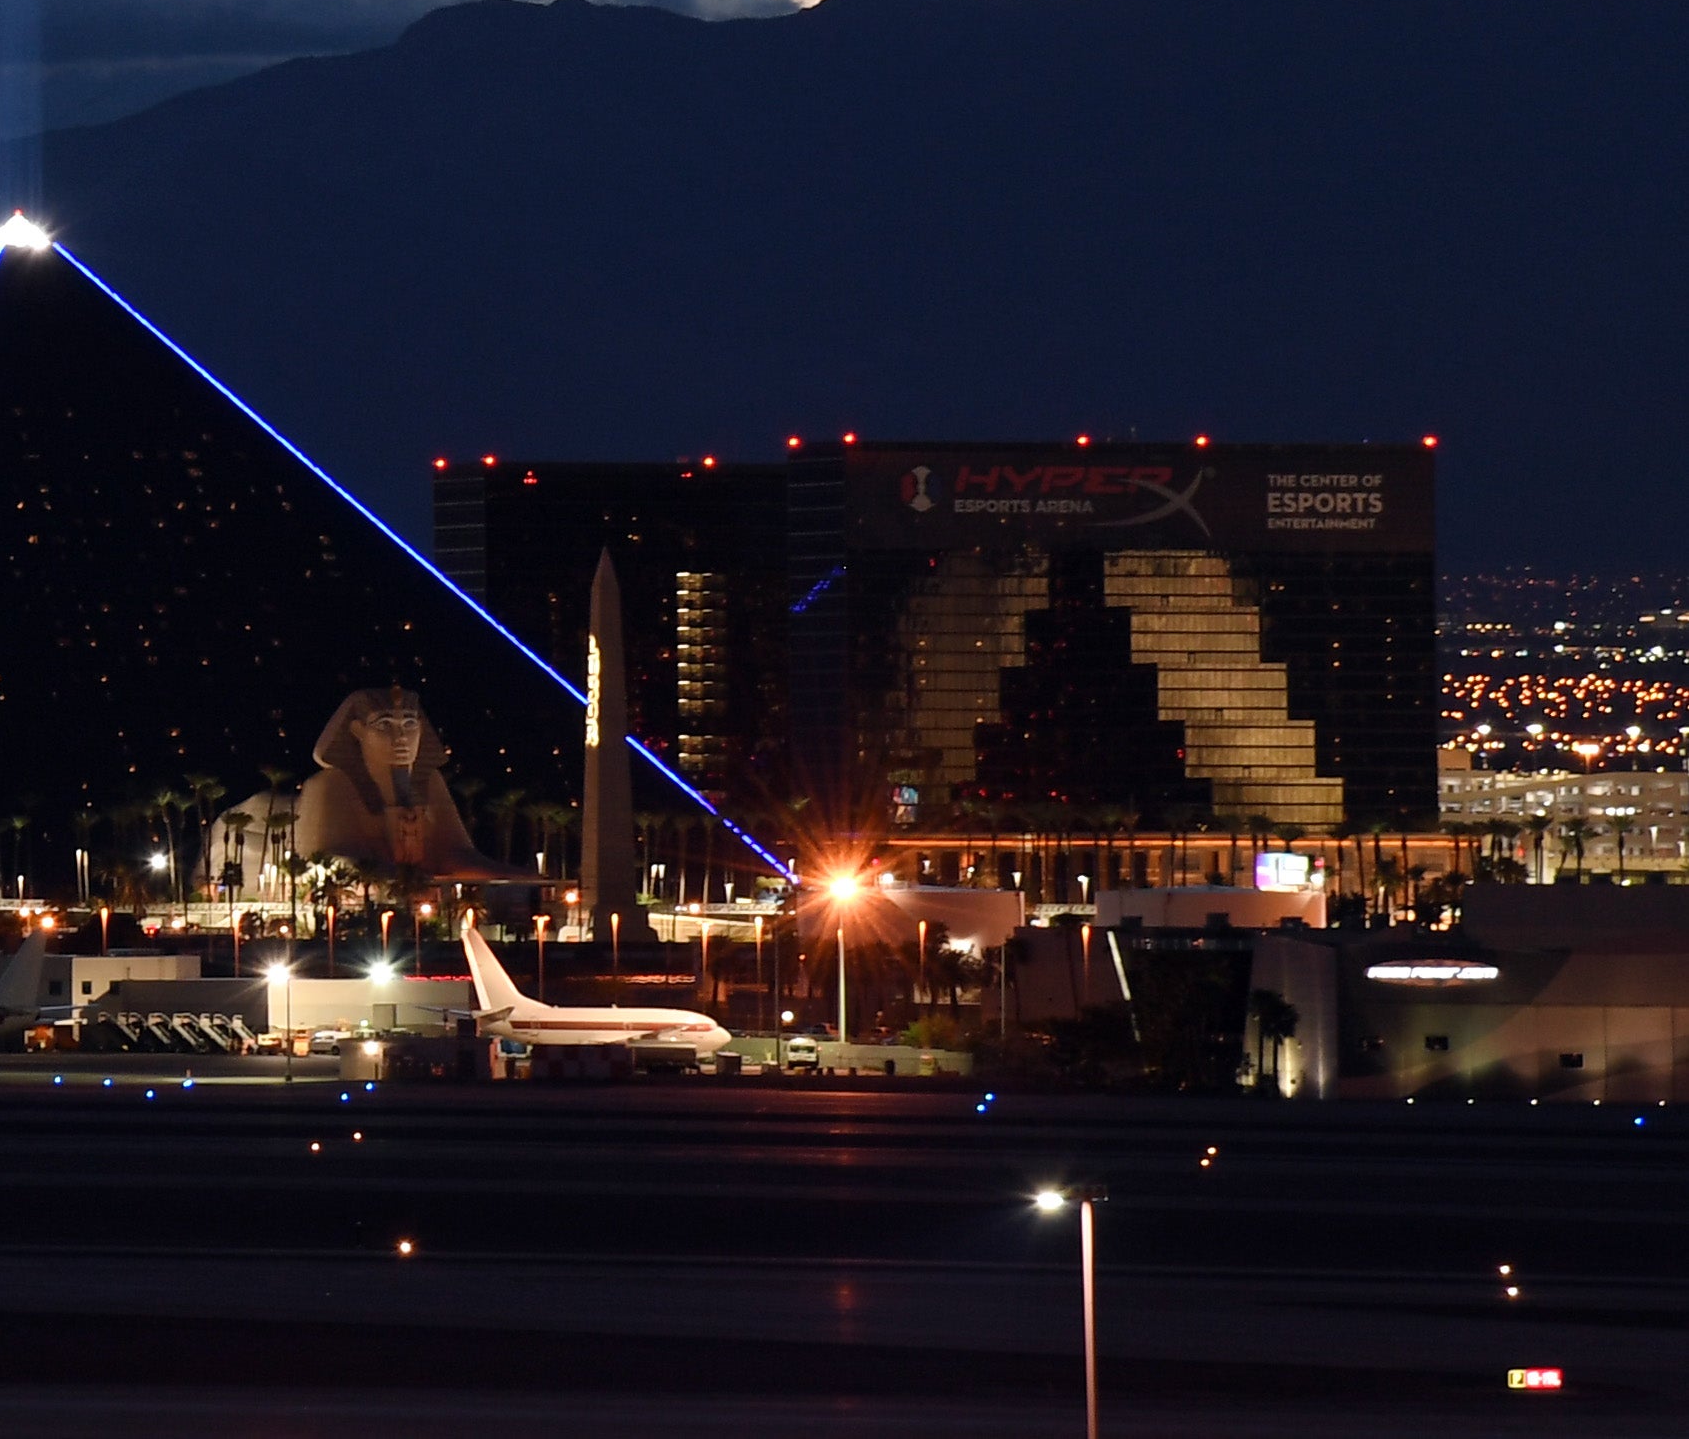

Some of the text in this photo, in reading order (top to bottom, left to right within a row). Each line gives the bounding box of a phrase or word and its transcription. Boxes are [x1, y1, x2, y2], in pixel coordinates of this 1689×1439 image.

[1267, 474, 1384, 487] THE CENTER OF
[954, 499, 1094, 513] ESPORTS ARENA
[1267, 492, 1384, 513] ESPORTS
[1267, 517, 1376, 530] ENTERTAINMENT
